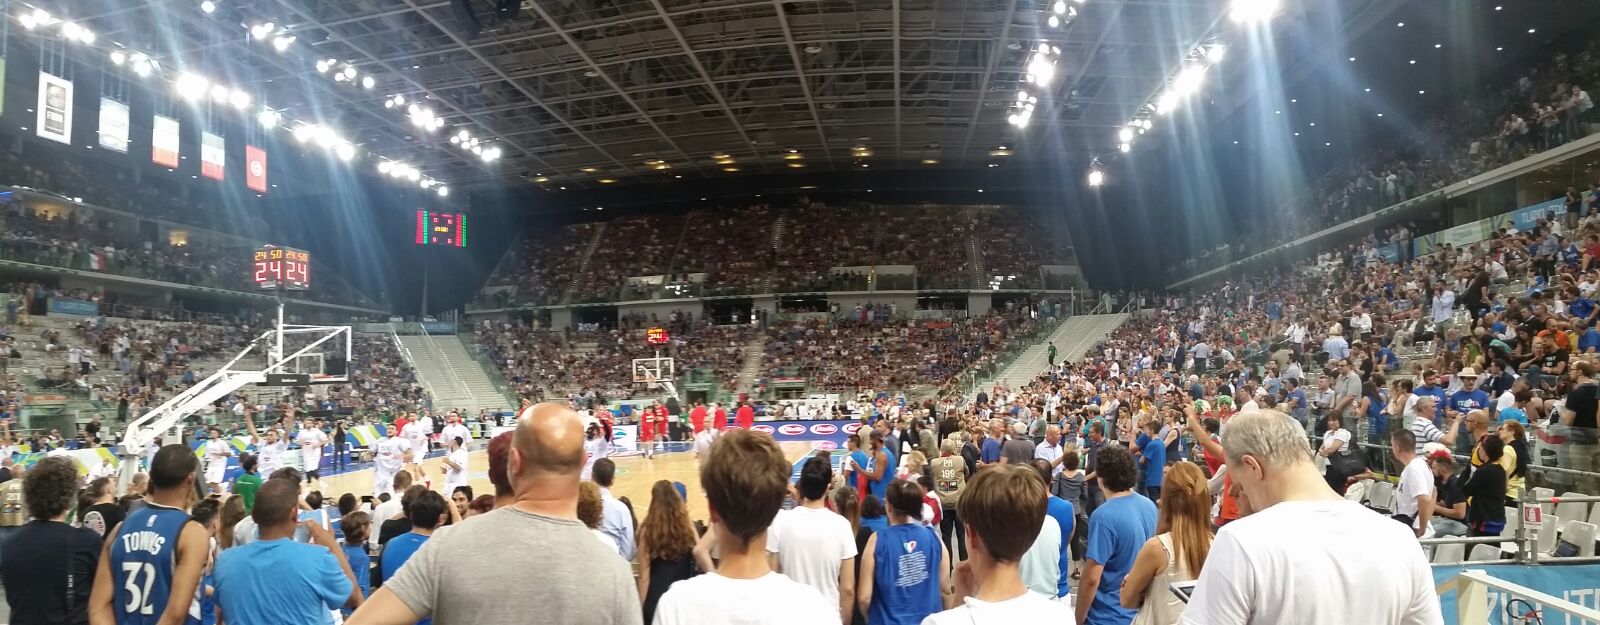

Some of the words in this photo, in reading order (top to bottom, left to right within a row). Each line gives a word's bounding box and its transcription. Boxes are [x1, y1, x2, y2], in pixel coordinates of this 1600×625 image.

[255, 260, 281, 282] 24
[286, 260, 307, 283] 24
[122, 530, 166, 556] TOWNS
[121, 561, 156, 615] 32
